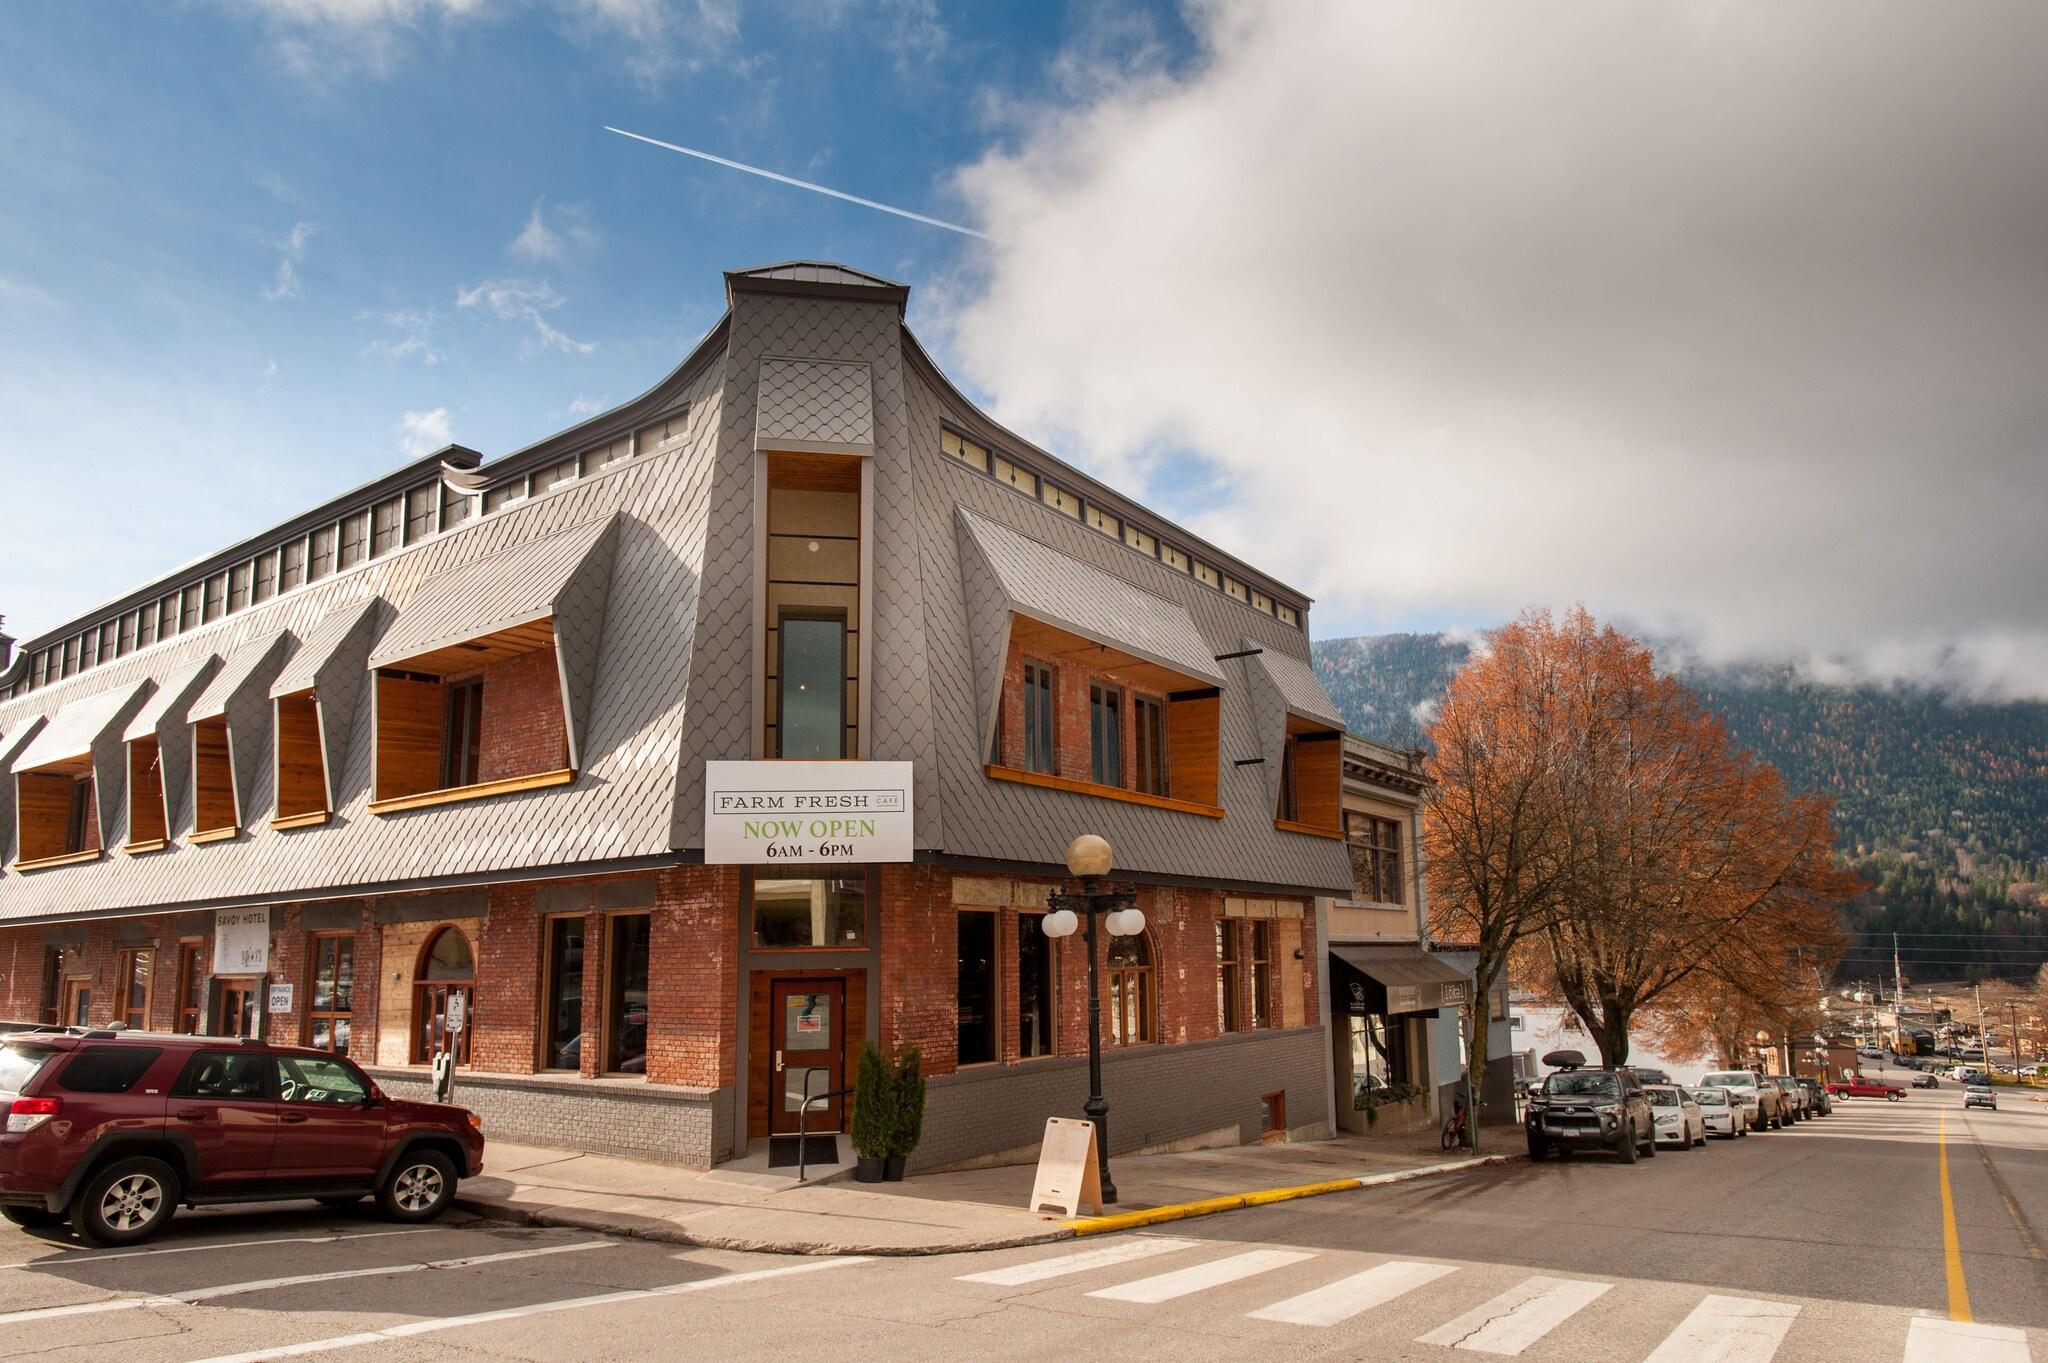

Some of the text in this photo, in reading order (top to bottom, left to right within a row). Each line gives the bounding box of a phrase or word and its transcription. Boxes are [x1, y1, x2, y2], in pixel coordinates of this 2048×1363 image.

[720, 796, 785, 809] FARM
[794, 795, 869, 808] FRESH
[743, 819, 876, 839] NOW OPEN
[766, 841, 803, 858] 6AM
[819, 840, 854, 857] 6PM
[217, 912, 266, 926] SAVOY HOTEL
[271, 996, 289, 1006] OPEN
